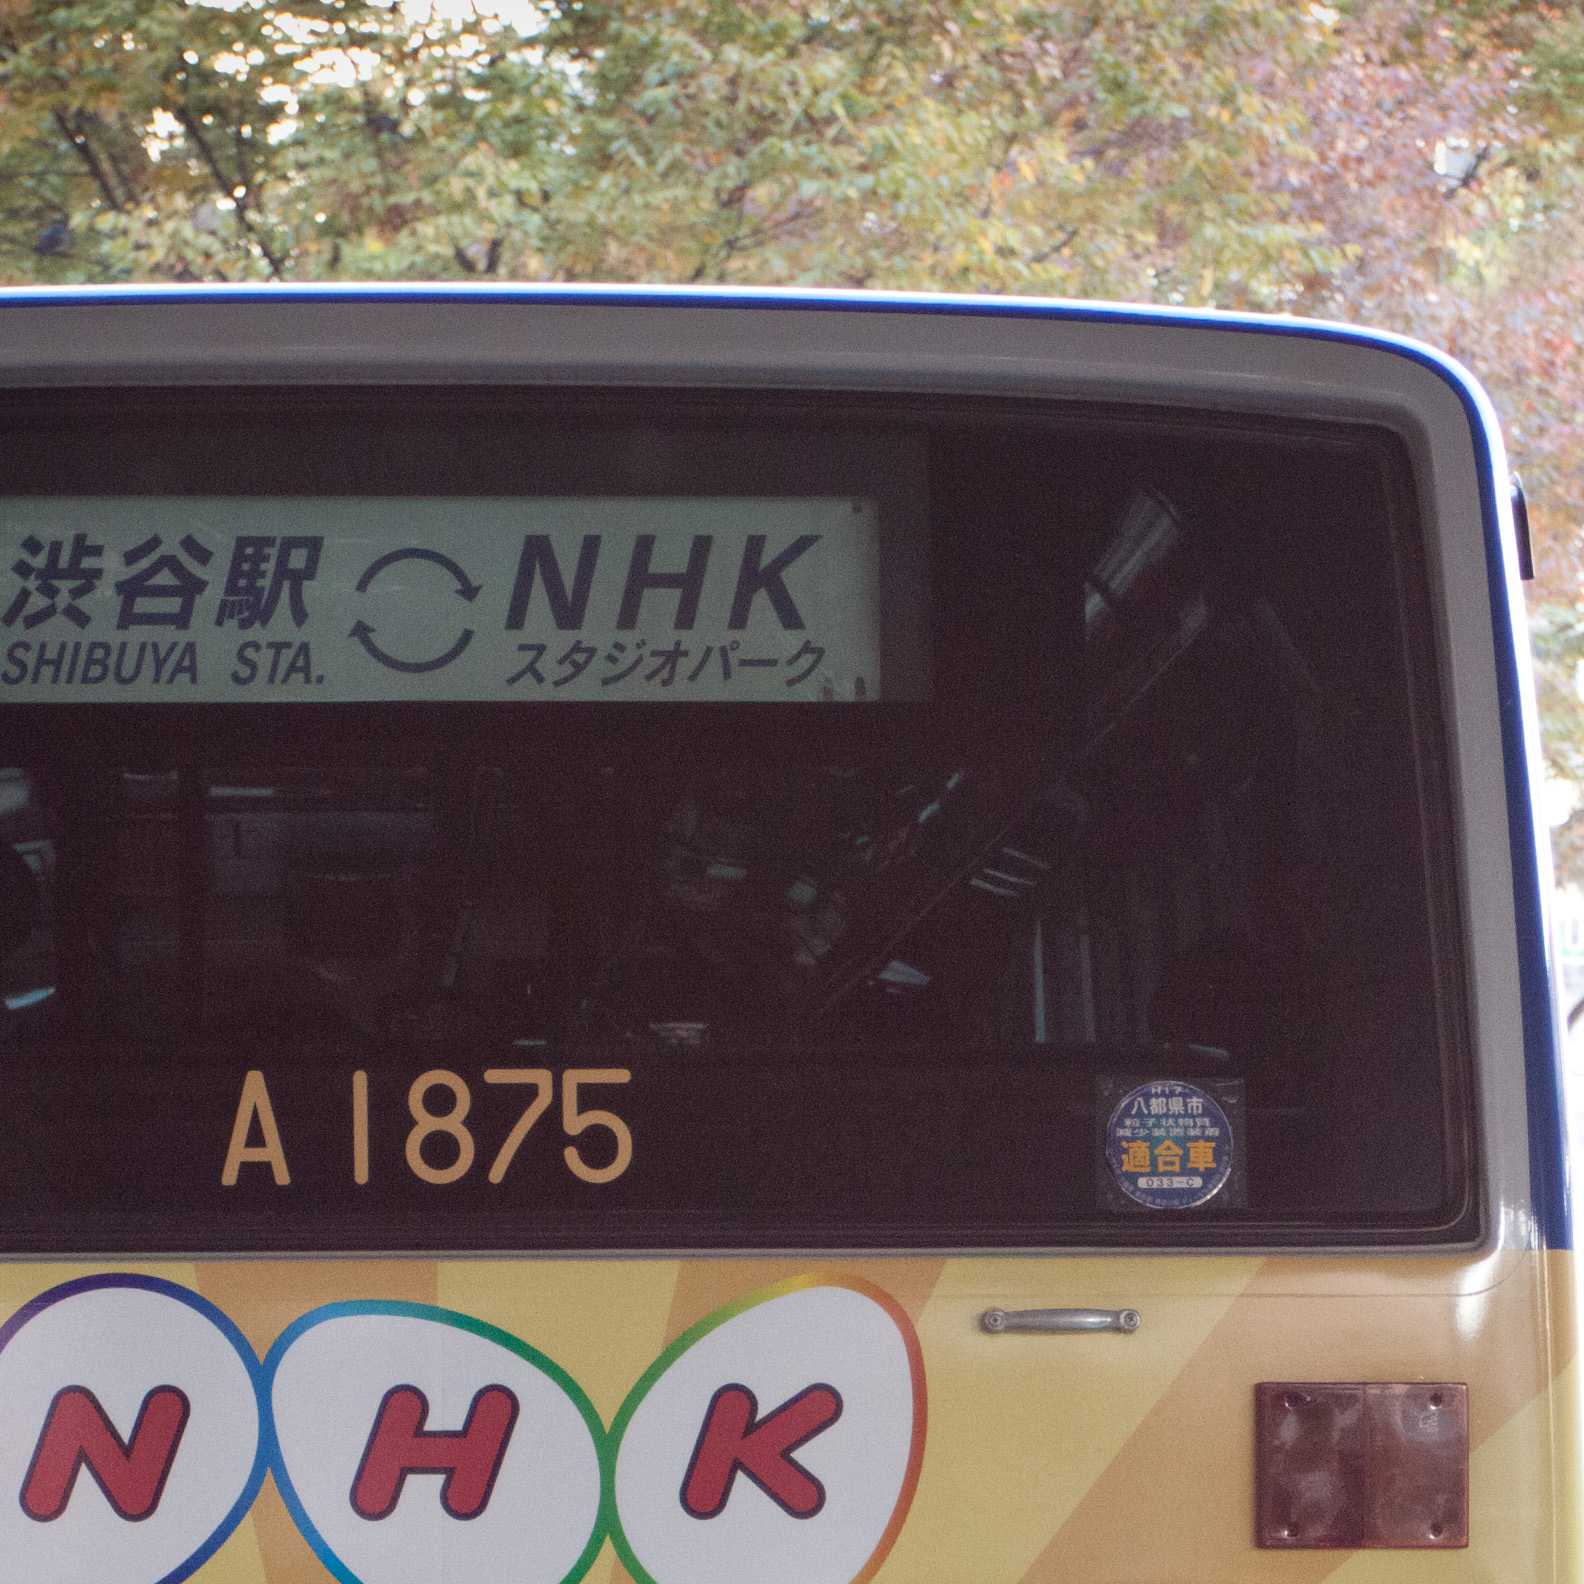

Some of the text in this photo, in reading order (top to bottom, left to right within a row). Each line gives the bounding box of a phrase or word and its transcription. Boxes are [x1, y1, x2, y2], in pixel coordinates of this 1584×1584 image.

[0, 533, 326, 630] 渋谷駅
[504, 534, 823, 631] NHK
[0, 640, 326, 686] SHIBUYA STA.
[504, 640, 827, 688] スタジオパーク
[221, 1068, 633, 1186] A 1875
[1131, 1097, 1204, 1115] 八都県市
[1120, 1140, 1217, 1173] 適合車
[18, 1383, 845, 1523] NHK
